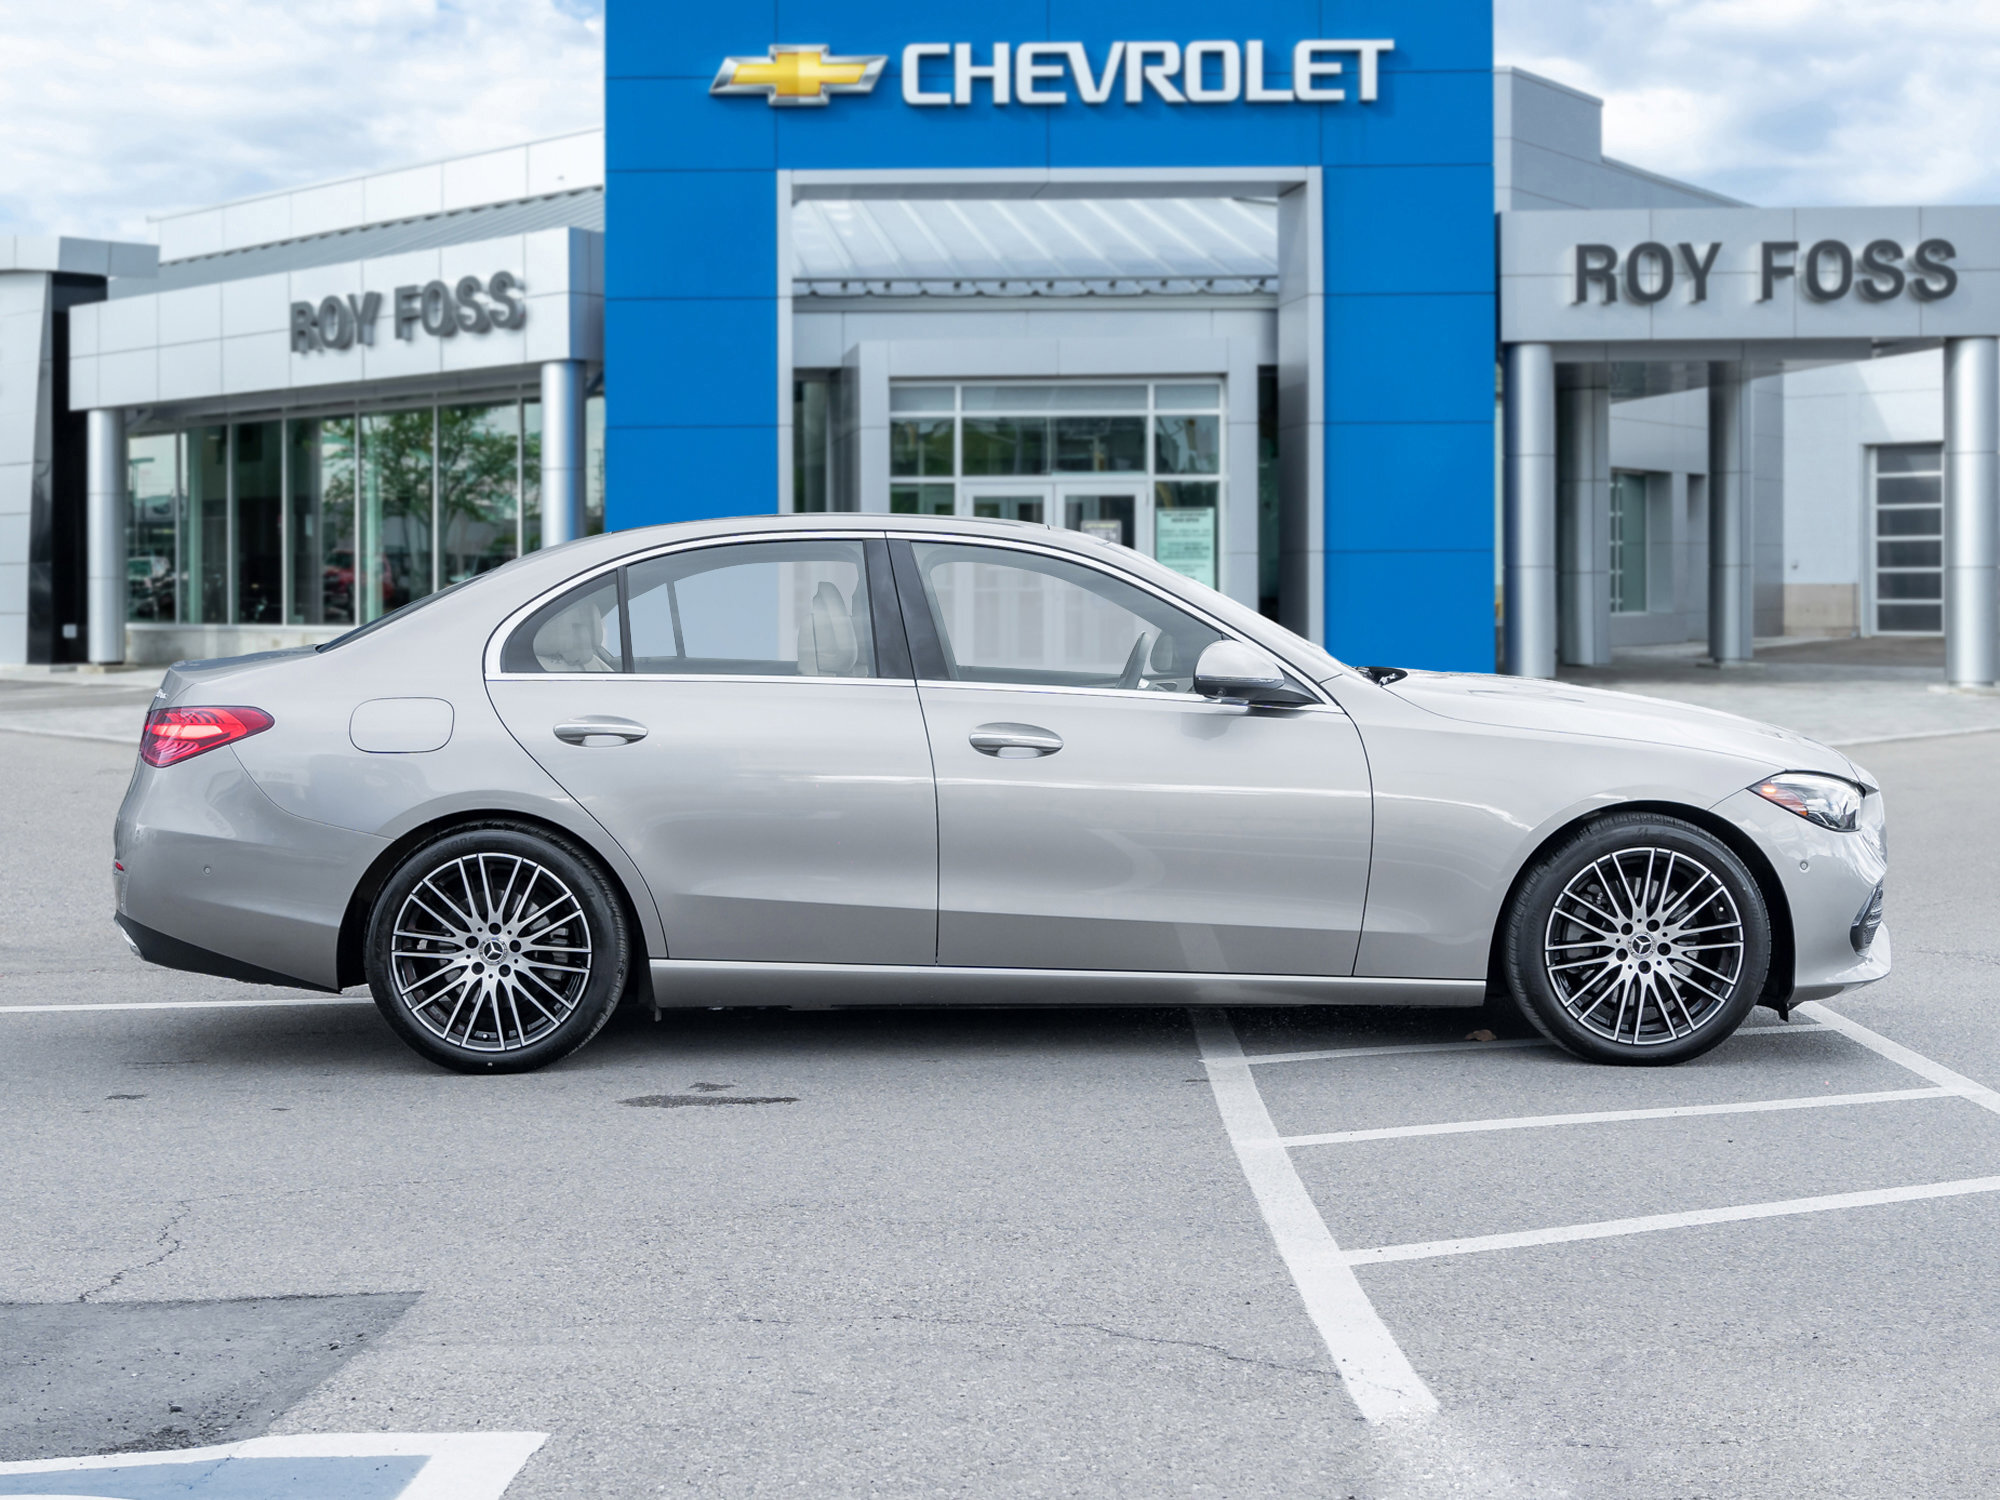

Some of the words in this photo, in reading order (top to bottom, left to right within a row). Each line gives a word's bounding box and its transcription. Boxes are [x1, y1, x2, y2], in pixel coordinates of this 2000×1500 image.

[902, 38, 1396, 105] CHEVROLET
[1574, 241, 1722, 304] ROY
[1758, 238, 1958, 303] FOSS
[290, 290, 383, 354] ROY
[394, 270, 527, 341] FOSS
